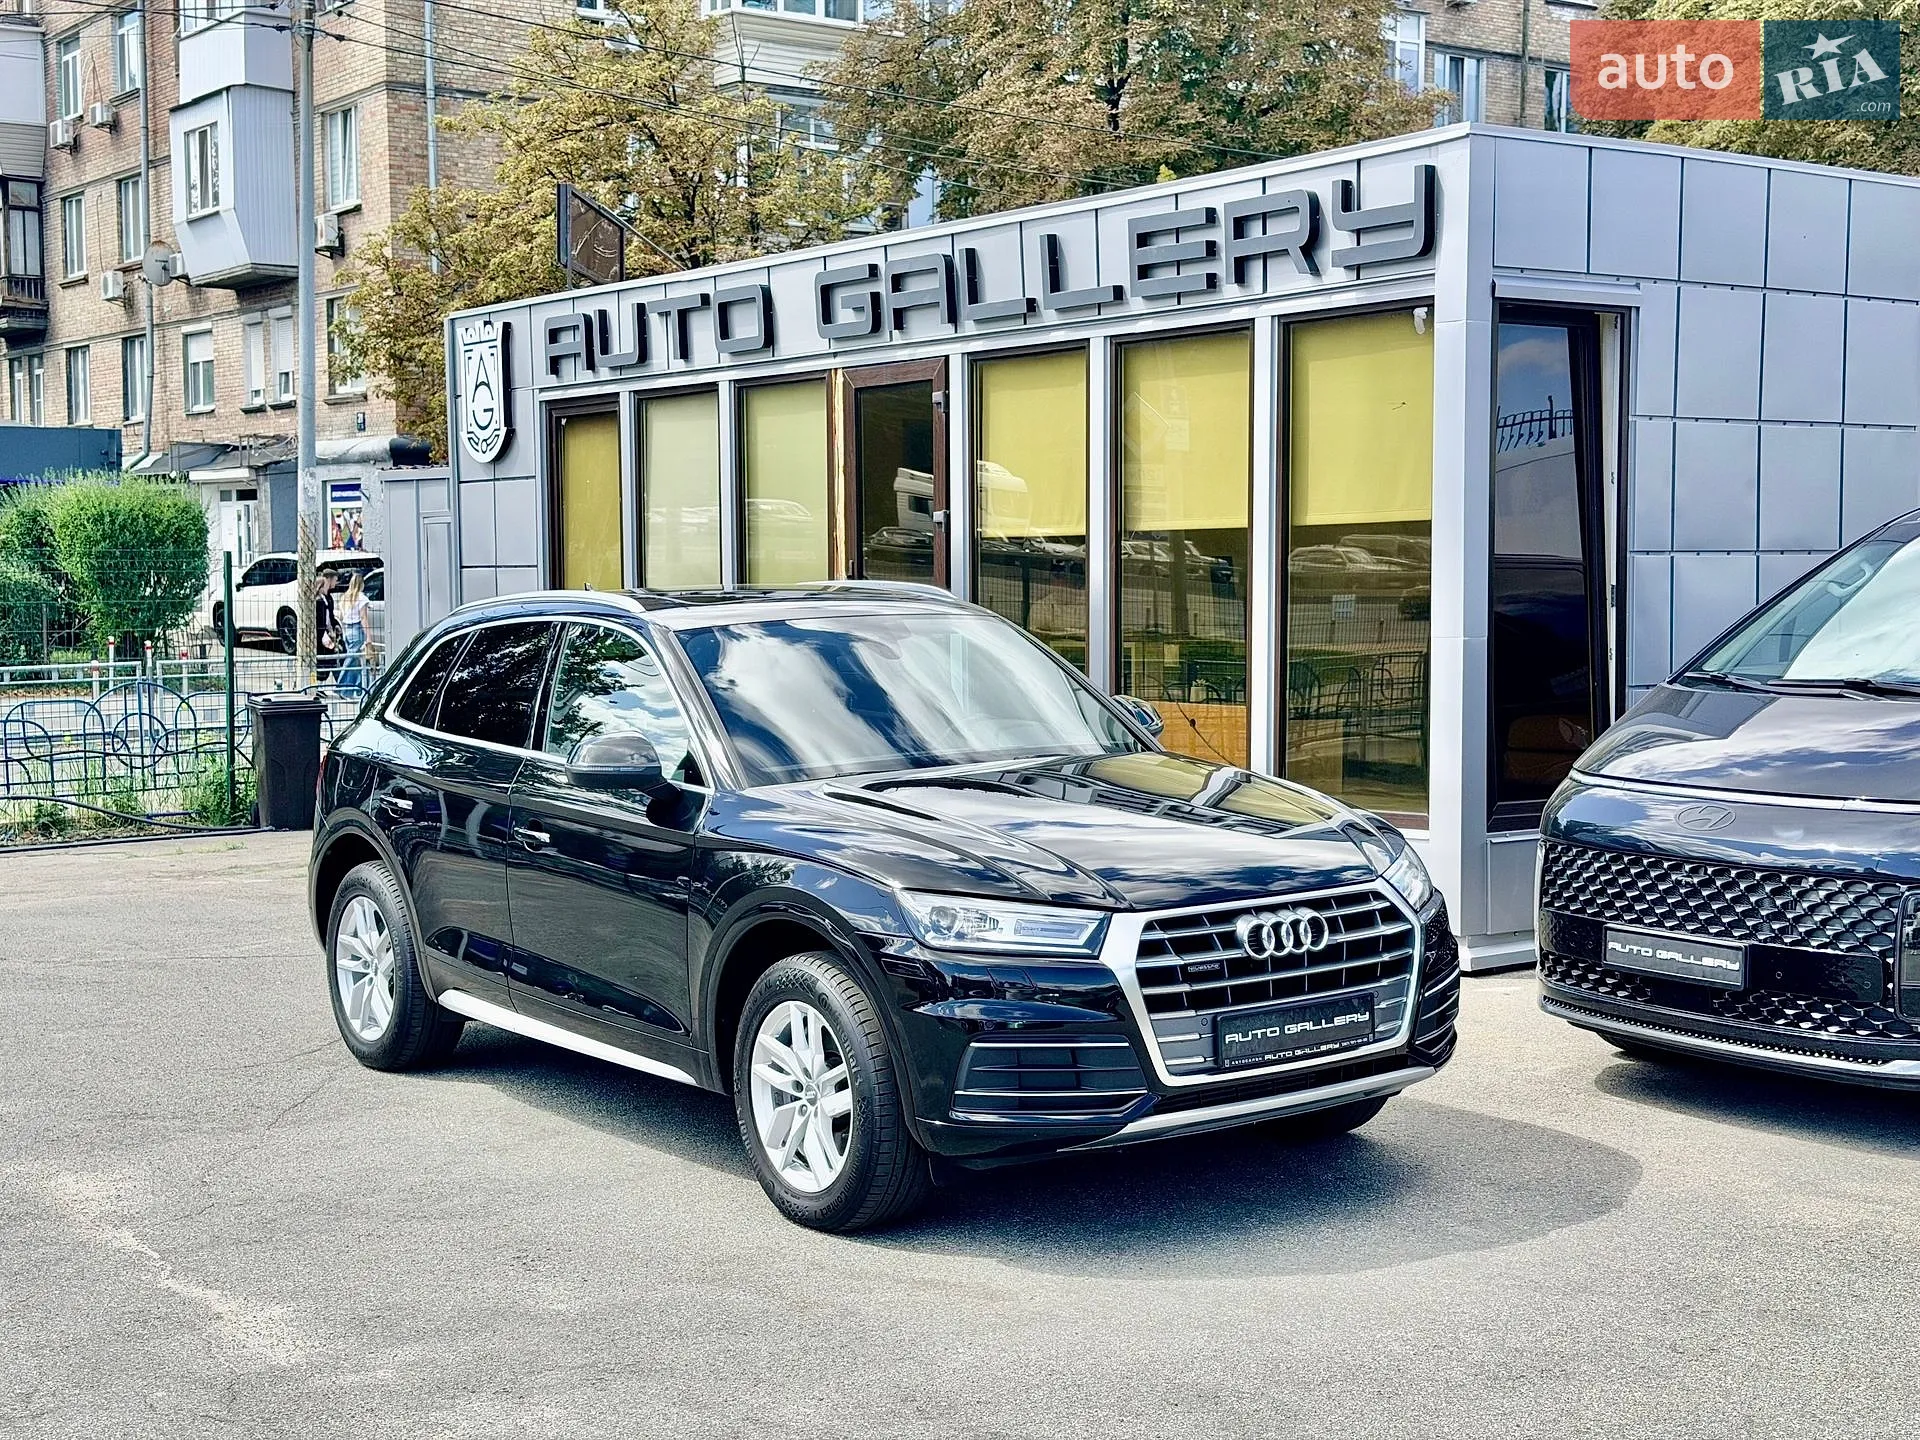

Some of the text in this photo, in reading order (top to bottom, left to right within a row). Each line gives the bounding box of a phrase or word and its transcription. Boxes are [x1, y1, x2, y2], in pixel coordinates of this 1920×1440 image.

[544, 164, 1436, 380] AUTO GALLERY
[1608, 942, 1740, 971] AUTO GALLERY
[1225, 1011, 1370, 1044] AUTO GALLERY
[1264, 1050, 1293, 1061] AUTO
